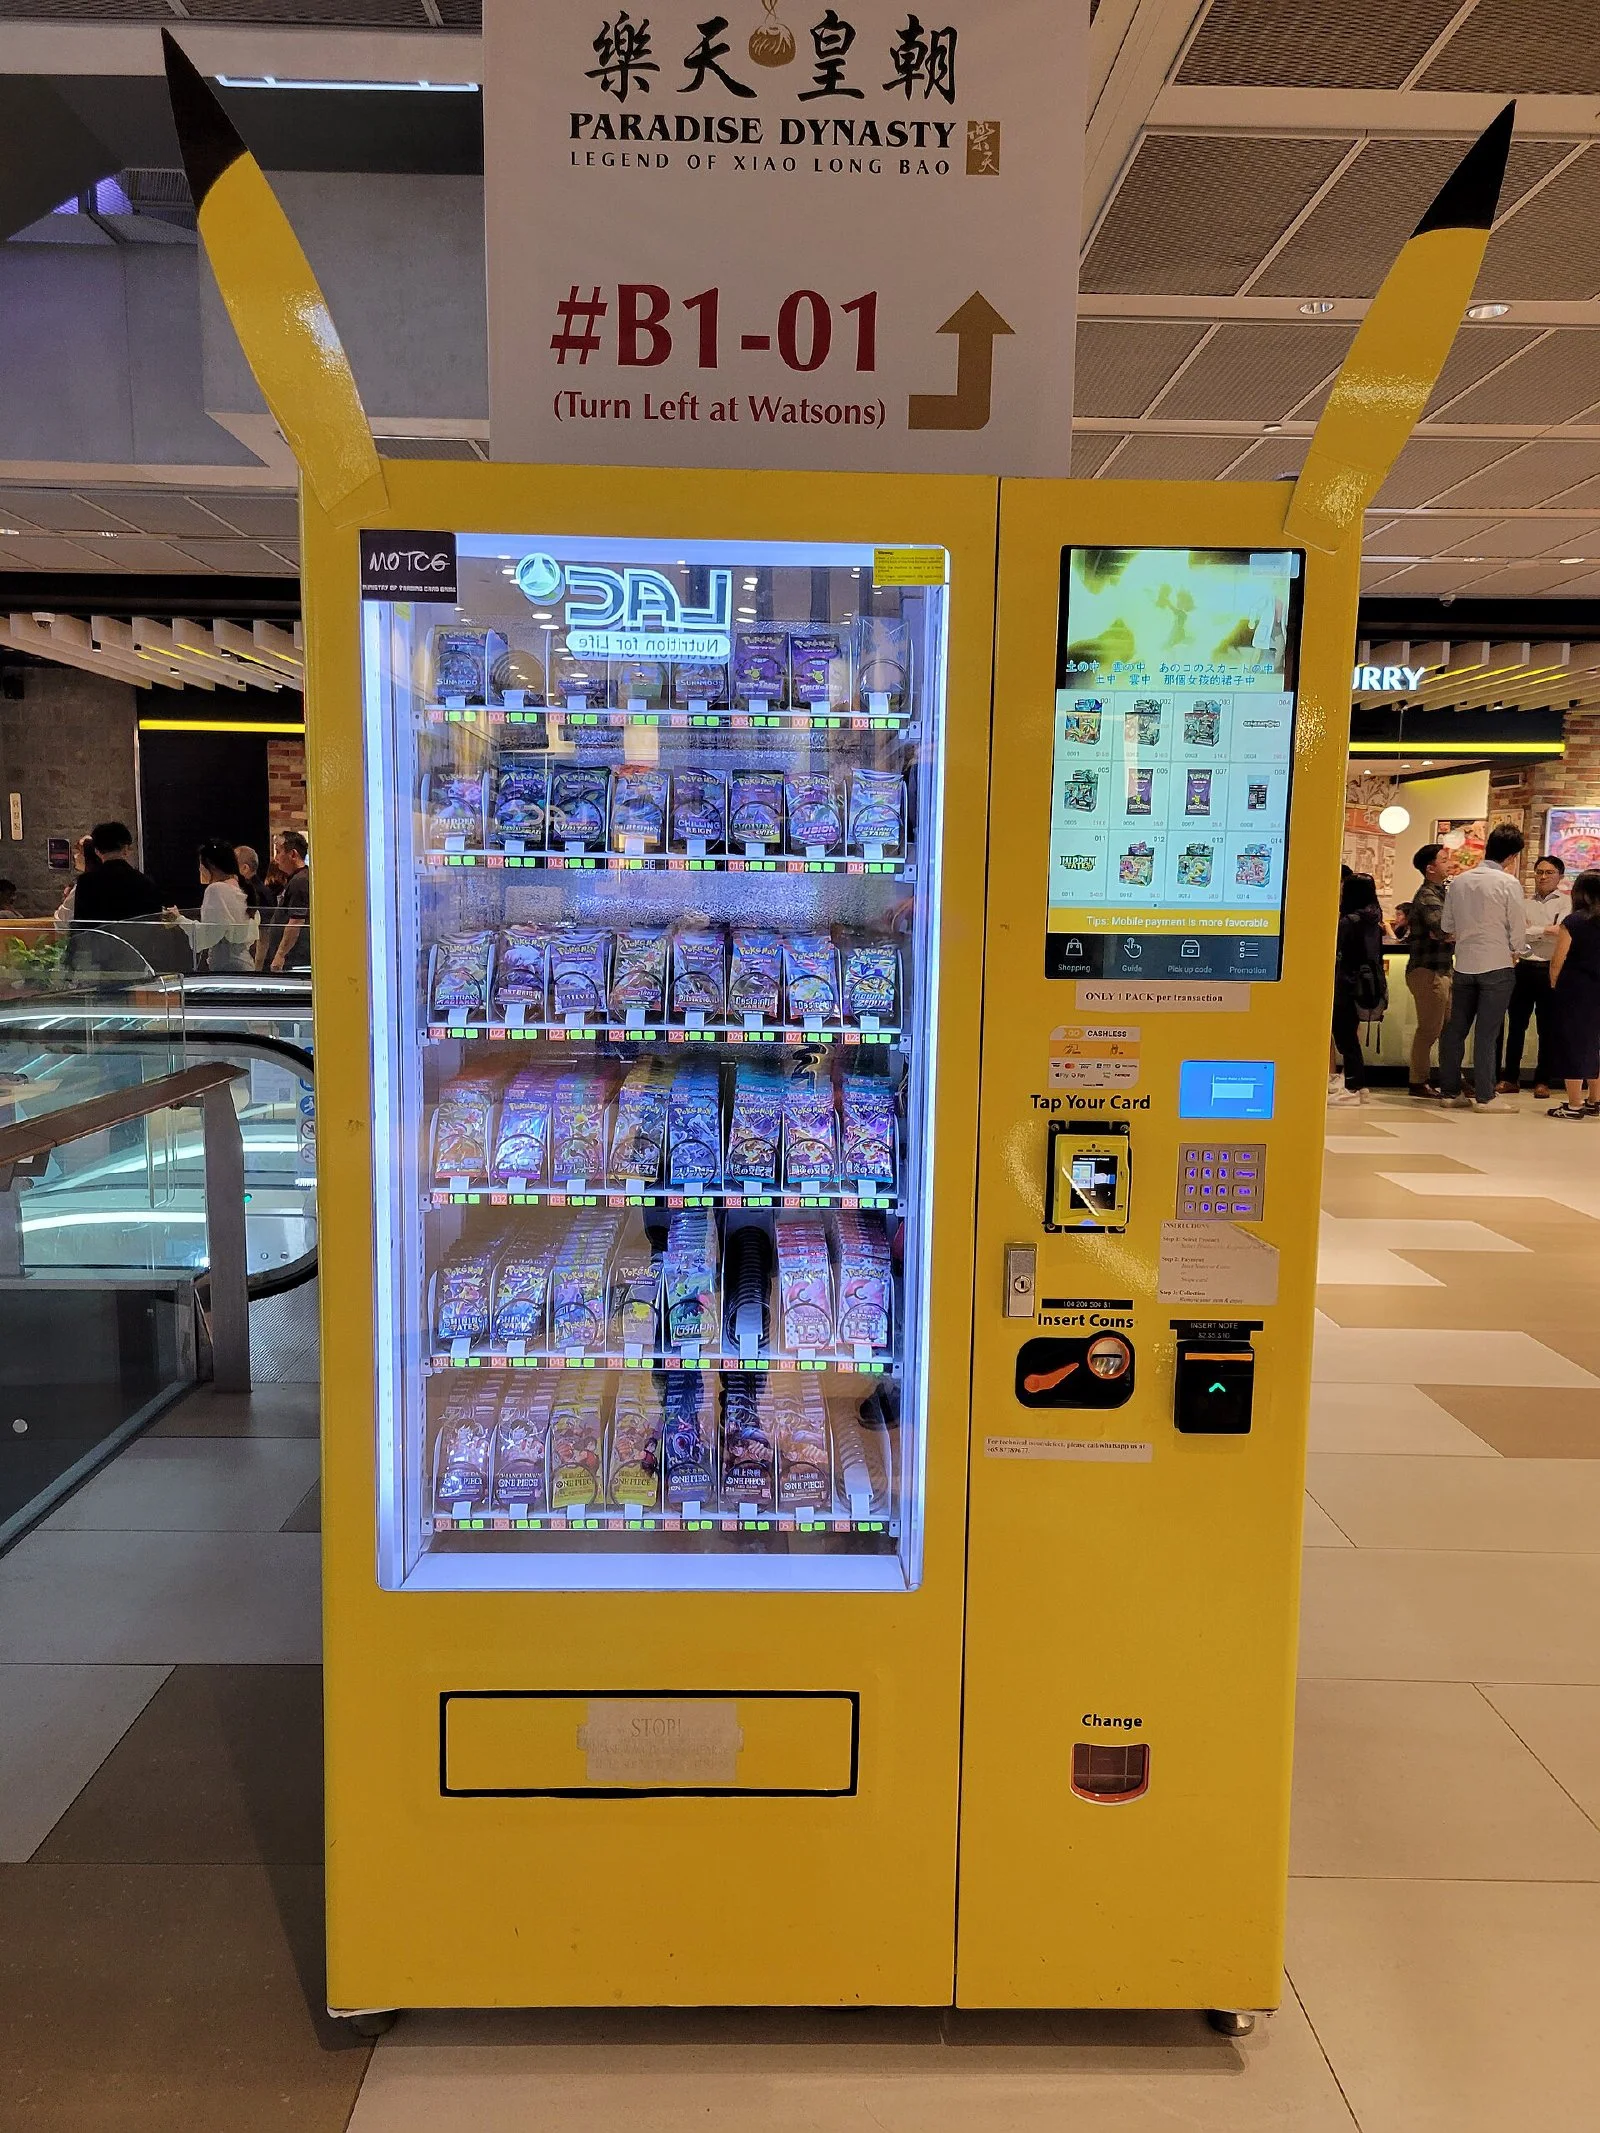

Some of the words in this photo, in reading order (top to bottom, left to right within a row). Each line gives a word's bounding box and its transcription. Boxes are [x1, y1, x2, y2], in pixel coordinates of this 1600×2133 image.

[569, 112, 763, 145] PARADISE
[779, 118, 956, 150] DYNASTY
[571, 151, 670, 169] LEGEND
[687, 153, 718, 171] OF
[733, 155, 797, 173] XIAO
[814, 157, 883, 174] LONG
[899, 158, 951, 176] BAO
[550, 284, 879, 373] #B1-01
[553, 390, 632, 422] (Turn
[643, 391, 700, 421] Left
[709, 396, 739, 422] at
[747, 395, 886, 430] Watsons)
[794, 717, 809, 727] 007
[678, 819, 721, 830] CHILLING
[686, 827, 712, 835] REIGN
[487, 857, 504, 866] 012
[548, 857, 563, 866] 013
[1060, 855, 1097, 866] HIDDEN
[668, 861, 684, 870] 015
[729, 861, 744, 870] 016
[788, 862, 804, 871] 017
[848, 862, 863, 871] 018
[1086, 915, 1109, 926] Tips:
[1111, 916, 1143, 926] Mobile
[1145, 918, 1186, 930] payment
[1187, 917, 1197, 927] is
[1199, 918, 1223, 927] more
[1225, 917, 1269, 929] favorable
[1057, 963, 1091, 973] Shopping
[1121, 964, 1143, 973] Guide
[1167, 965, 1183, 973] Pick
[1184, 966, 1193, 975] up
[1194, 965, 1213, 974] code
[1229, 966, 1267, 975] Promotion
[1085, 992, 1116, 1001] ONLY
[1125, 992, 1154, 1001] PACK
[1156, 994, 1171, 1003] per
[1173, 994, 1223, 1002] transaction
[429, 1029, 445, 1037] 021
[490, 1030, 505, 1038] 022
[549, 1030, 565, 1038] 023
[609, 1031, 625, 1039] 024
[668, 1032, 684, 1040] 025
[728, 1032, 744, 1040] 026
[787, 1033, 801, 1041] 027
[846, 1033, 861, 1041] 028
[1087, 1030, 1127, 1038] CASHLESS
[1030, 1094, 1062, 1112] Tap
[1066, 1094, 1106, 1109] Your
[1110, 1094, 1151, 1109] Card
[491, 1195, 507, 1204] 032
[668, 1197, 683, 1206] 035
[784, 1198, 799, 1206] 037
[1037, 1313, 1086, 1326] Insert
[1089, 1313, 1134, 1328] Coins
[1218, 1322, 1239, 1330] NOTE
[550, 1358, 564, 1366] 043
[608, 1359, 623, 1367] 044
[499, 1478, 517, 1488] ONE
[517, 1479, 539, 1488] PIECE
[671, 1475, 690, 1484] ONE
[726, 1477, 743, 1485] ONE
[744, 1477, 766, 1486] PIECE
[784, 1482, 802, 1491] ONE
[803, 1481, 825, 1489] PIECE
[551, 1520, 566, 1529] 053
[1081, 1713, 1143, 1731] Change
[631, 1718, 682, 1738] STOP!
